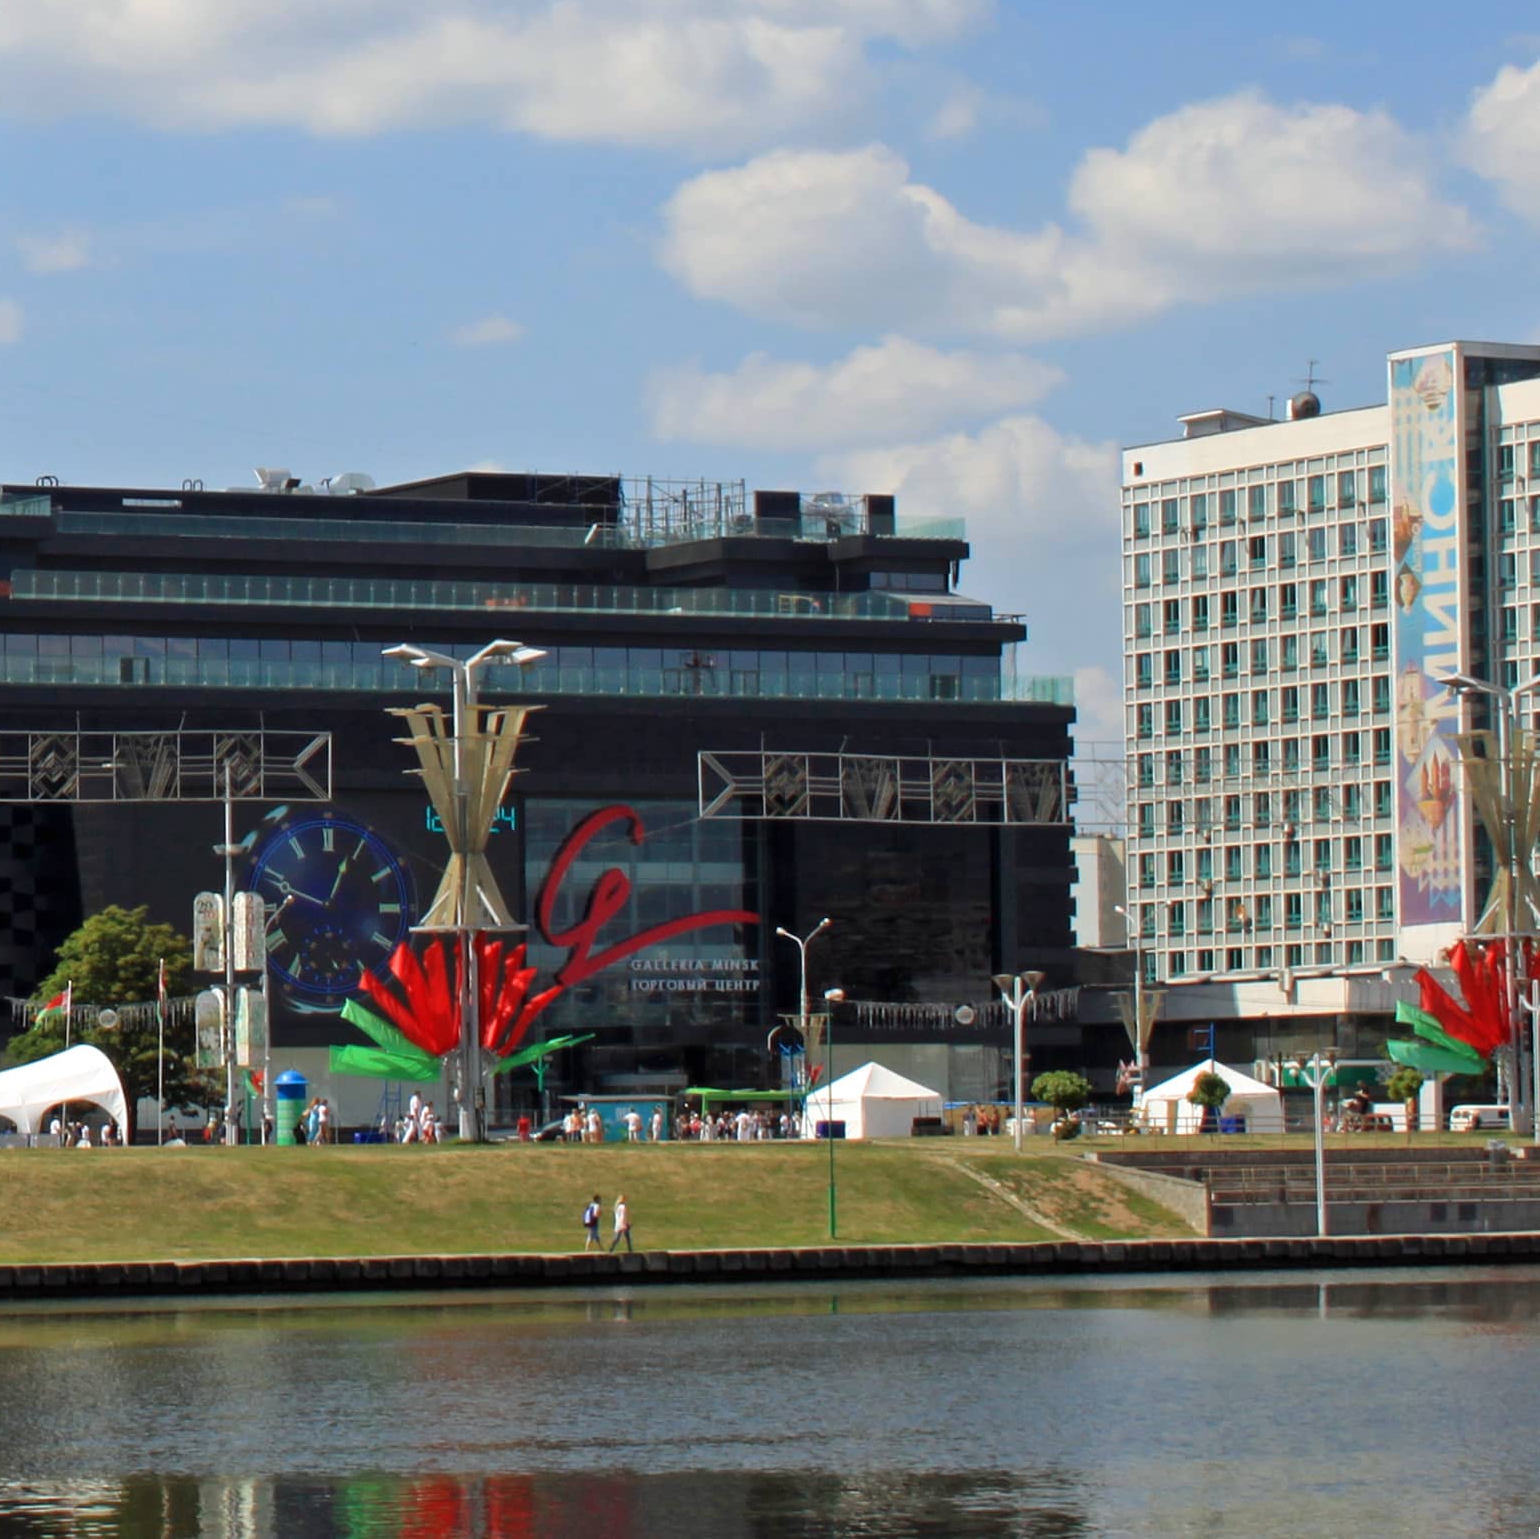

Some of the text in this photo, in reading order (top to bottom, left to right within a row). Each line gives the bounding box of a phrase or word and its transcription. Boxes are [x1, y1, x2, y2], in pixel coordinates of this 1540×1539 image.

[631, 959, 760, 971] GALLERIA MINSK
[715, 979, 760, 993] ЦЕНТР
